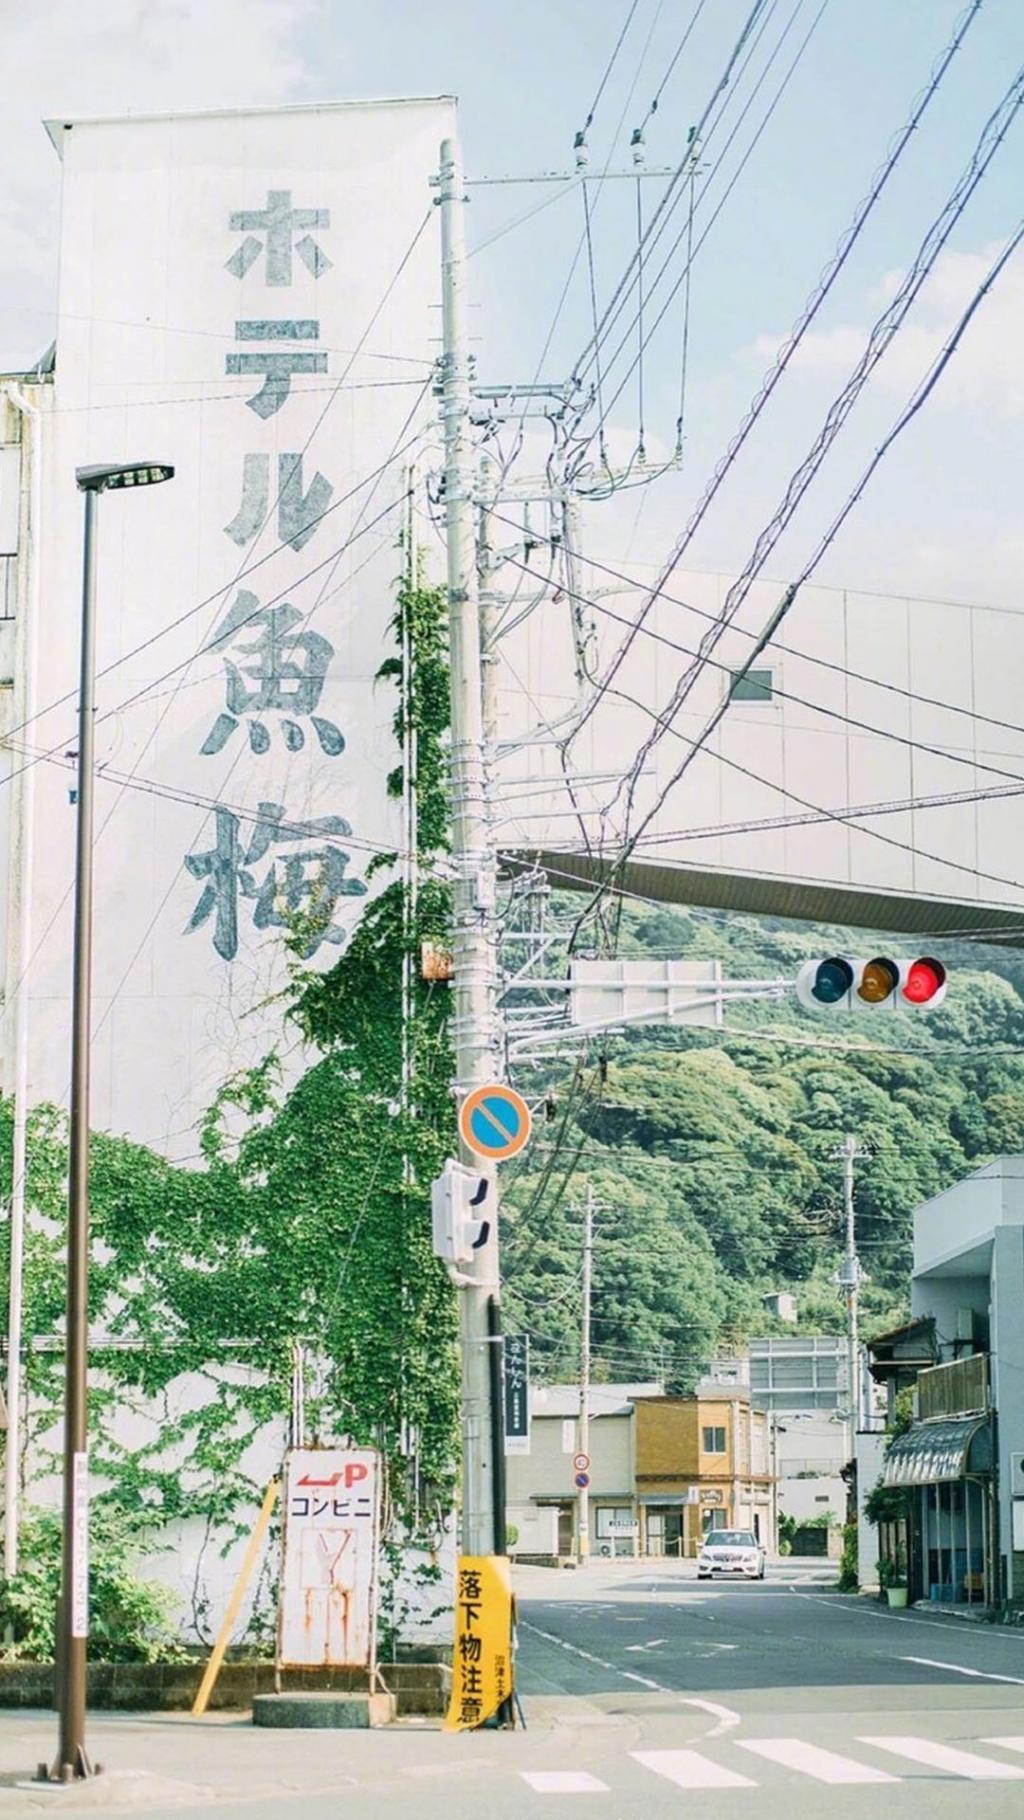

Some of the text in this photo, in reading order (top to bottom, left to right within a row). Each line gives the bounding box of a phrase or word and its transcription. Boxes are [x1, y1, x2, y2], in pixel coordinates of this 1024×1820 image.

[182, 188, 369, 962] ホテル魚梅
[291, 1497, 371, 1517] コンビニ
[345, 1463, 369, 1488] P
[457, 1569, 483, 1723] 落下物注意
